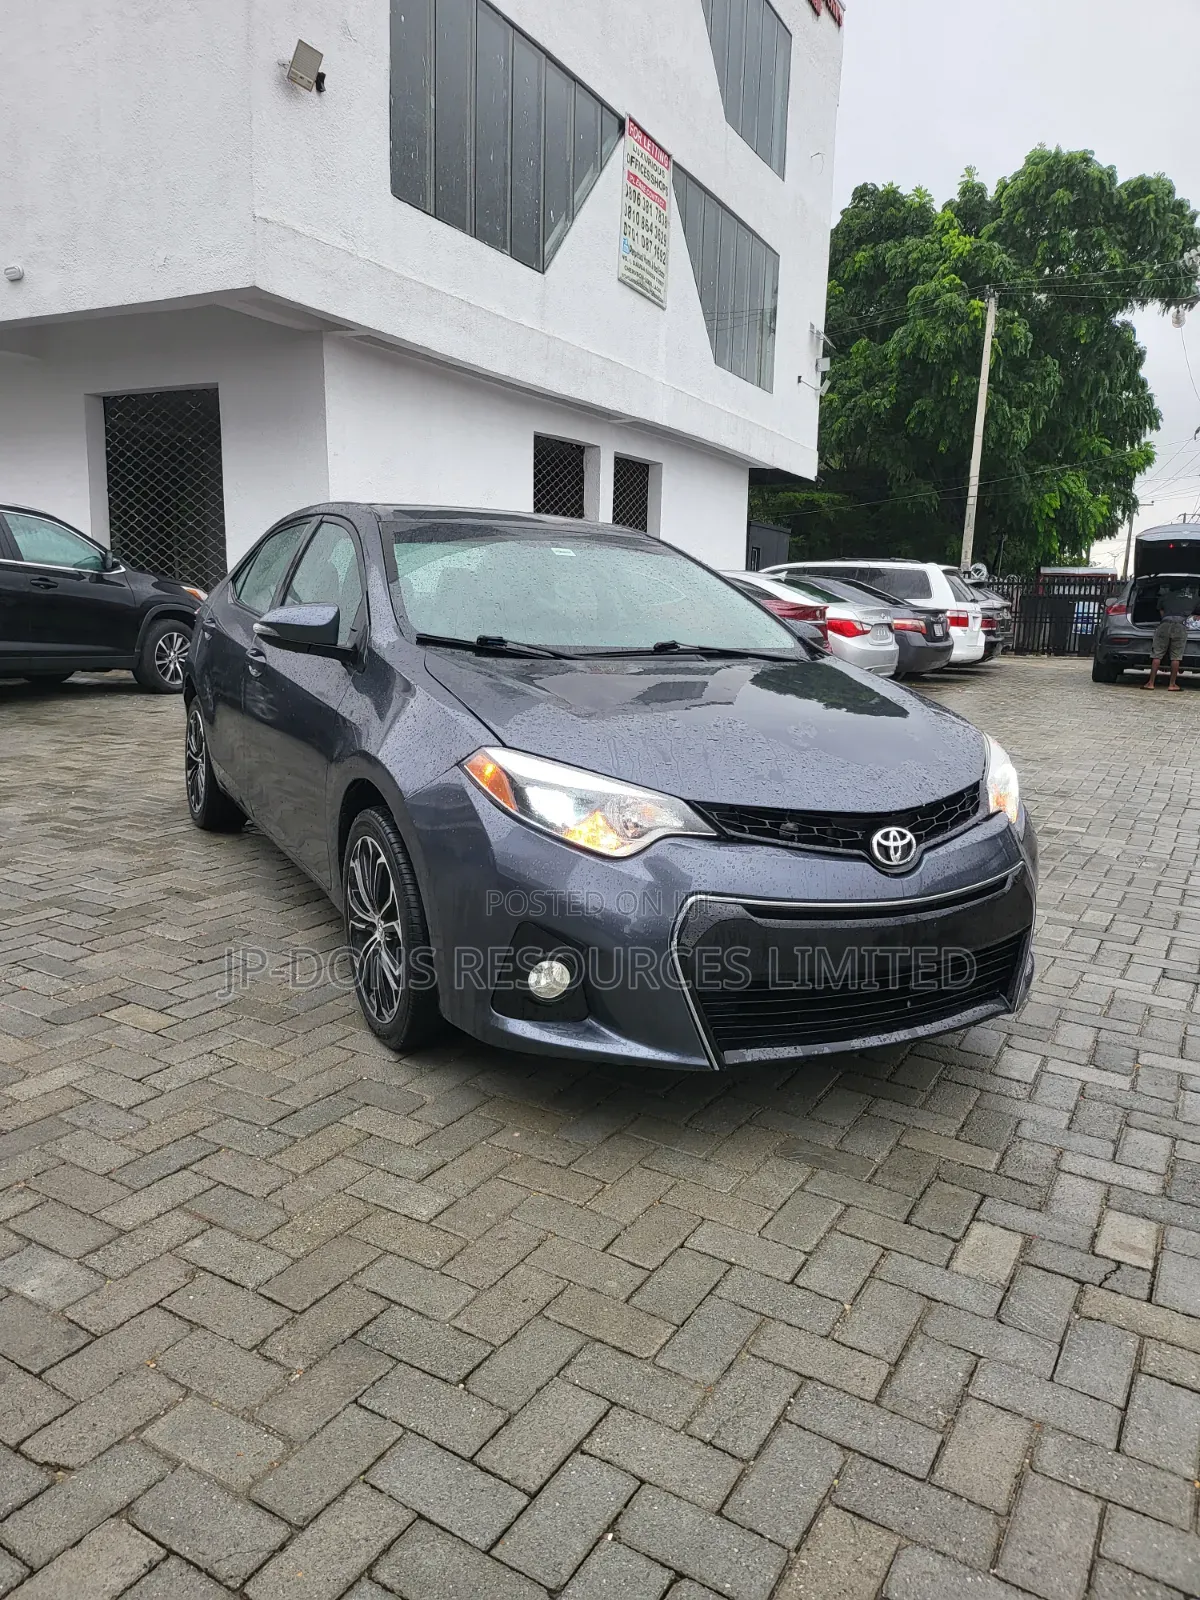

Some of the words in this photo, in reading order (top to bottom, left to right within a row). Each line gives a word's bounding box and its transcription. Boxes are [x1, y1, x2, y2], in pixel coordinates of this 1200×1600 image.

[629, 122, 642, 145] FOR
[644, 135, 669, 169] LETTING
[633, 143, 665, 179] LUXURIOUS
[623, 221, 638, 244] 0701
